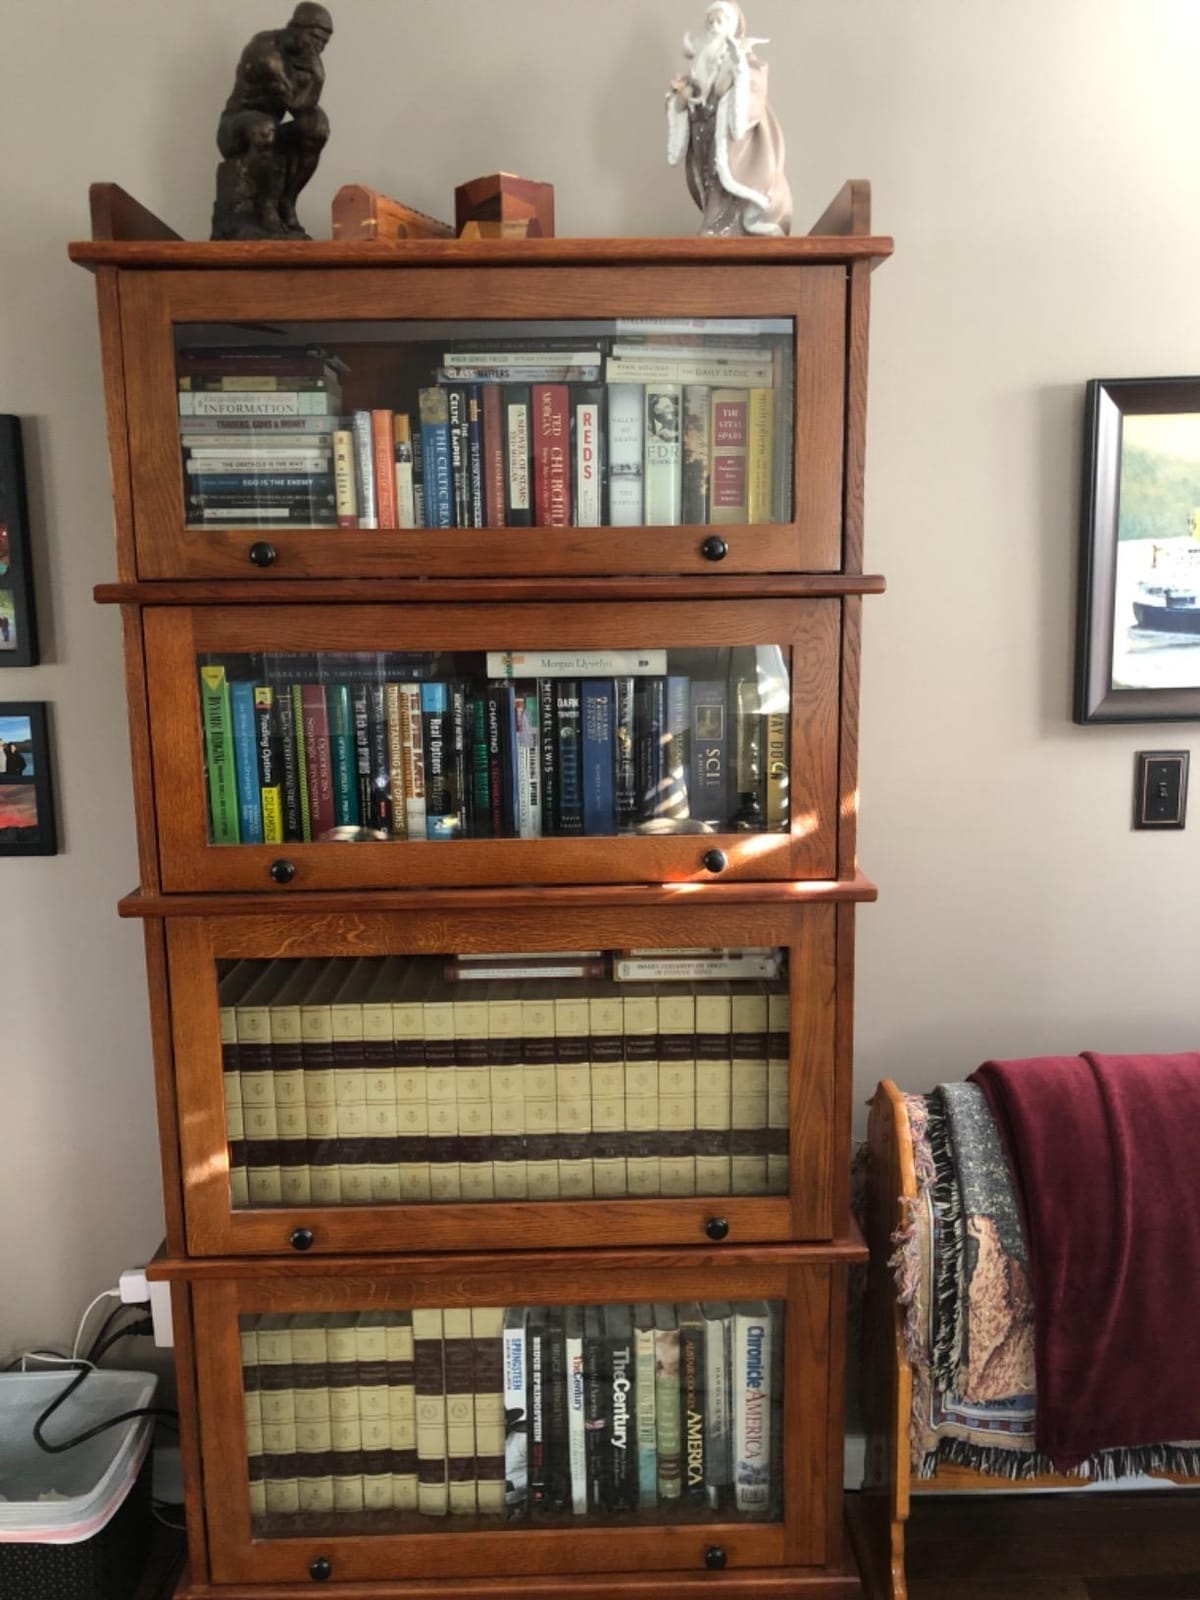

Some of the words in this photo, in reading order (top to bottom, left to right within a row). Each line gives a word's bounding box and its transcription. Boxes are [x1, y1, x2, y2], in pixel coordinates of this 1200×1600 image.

[695, 369, 722, 377] DAILY
[203, 400, 295, 414] INFORMATION
[449, 393, 461, 425] CELTIC
[542, 391, 552, 436] MORGAN
[552, 412, 562, 436] TED
[435, 428, 448, 455] THE
[451, 428, 462, 467] EMPIRE
[583, 411, 593, 480] REDS
[647, 445, 682, 458] FDR
[242, 479, 259, 487] EGO
[260, 479, 269, 487] IS
[269, 479, 285, 487] THE
[286, 479, 314, 487] ENEMY
[438, 456, 450, 500] CELTIC
[543, 682, 554, 733] MICHAEL
[556, 697, 580, 708] DARK
[260, 713, 271, 747] Trading
[388, 686, 402, 767] UNDERSTANDING
[430, 718, 441, 738] Real
[488, 699, 498, 754] CHARTING
[262, 749, 273, 783] Options
[430, 740, 442, 774] Options
[544, 737, 554, 774] LEWIS
[264, 794, 277, 842] DUMMIES
[393, 788, 405, 829] OPTIONS
[511, 1337, 523, 1391] SPRINGSTEEN
[532, 1336, 542, 1370] BRUCE
[746, 1325, 765, 1389] Chronicle
[533, 1371, 543, 1443] SPRINGSTEEN
[744, 1389, 768, 1460] AMERICA
[687, 1409, 702, 1486] AMERICA
